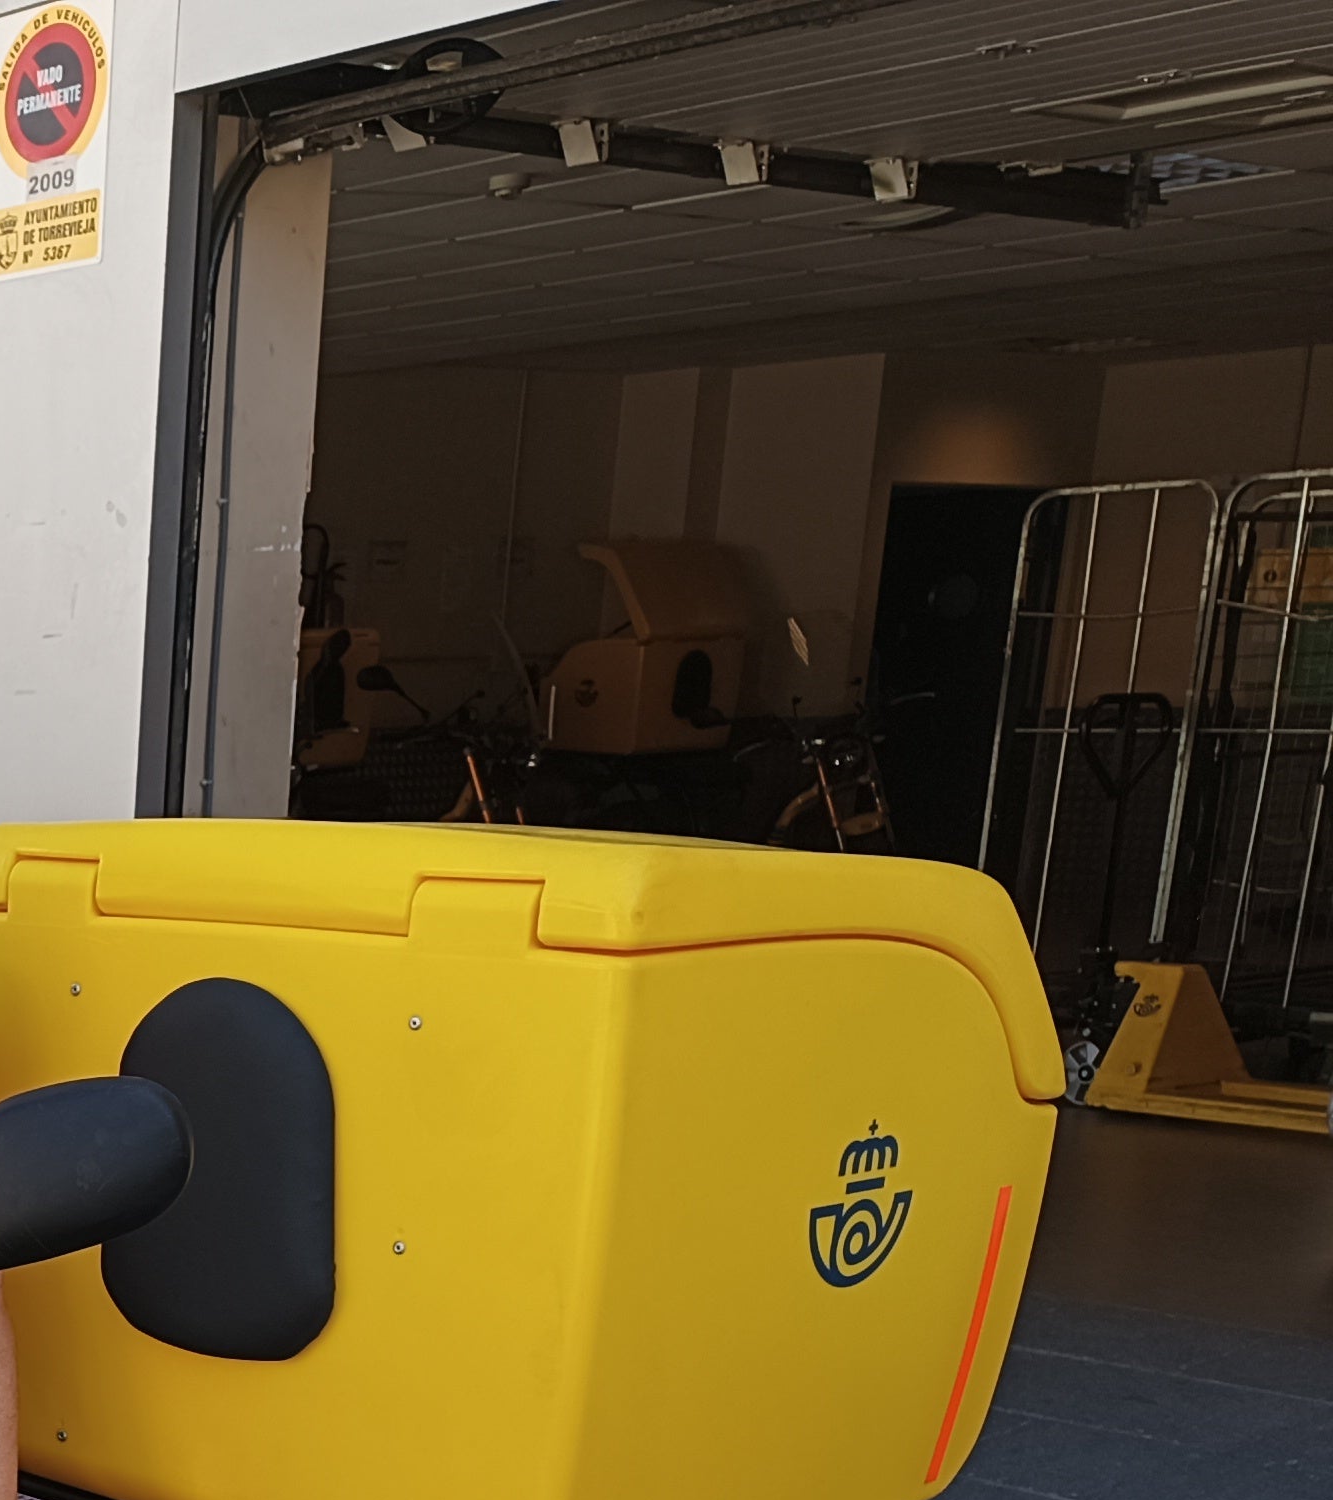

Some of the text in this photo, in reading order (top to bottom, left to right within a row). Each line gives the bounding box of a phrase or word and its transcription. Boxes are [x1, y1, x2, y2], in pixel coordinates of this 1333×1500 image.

[33, 13, 49, 31] DE
[56, 9, 106, 70] VEHICULOS
[36, 64, 64, 89] VADO
[17, 83, 82, 117] PERMANENTE
[28, 168, 75, 195] 2009
[23, 197, 98, 226] AYUNTAMIENTO
[23, 217, 96, 246] DE TORREVIEJA
[42, 243, 72, 262] 5367
